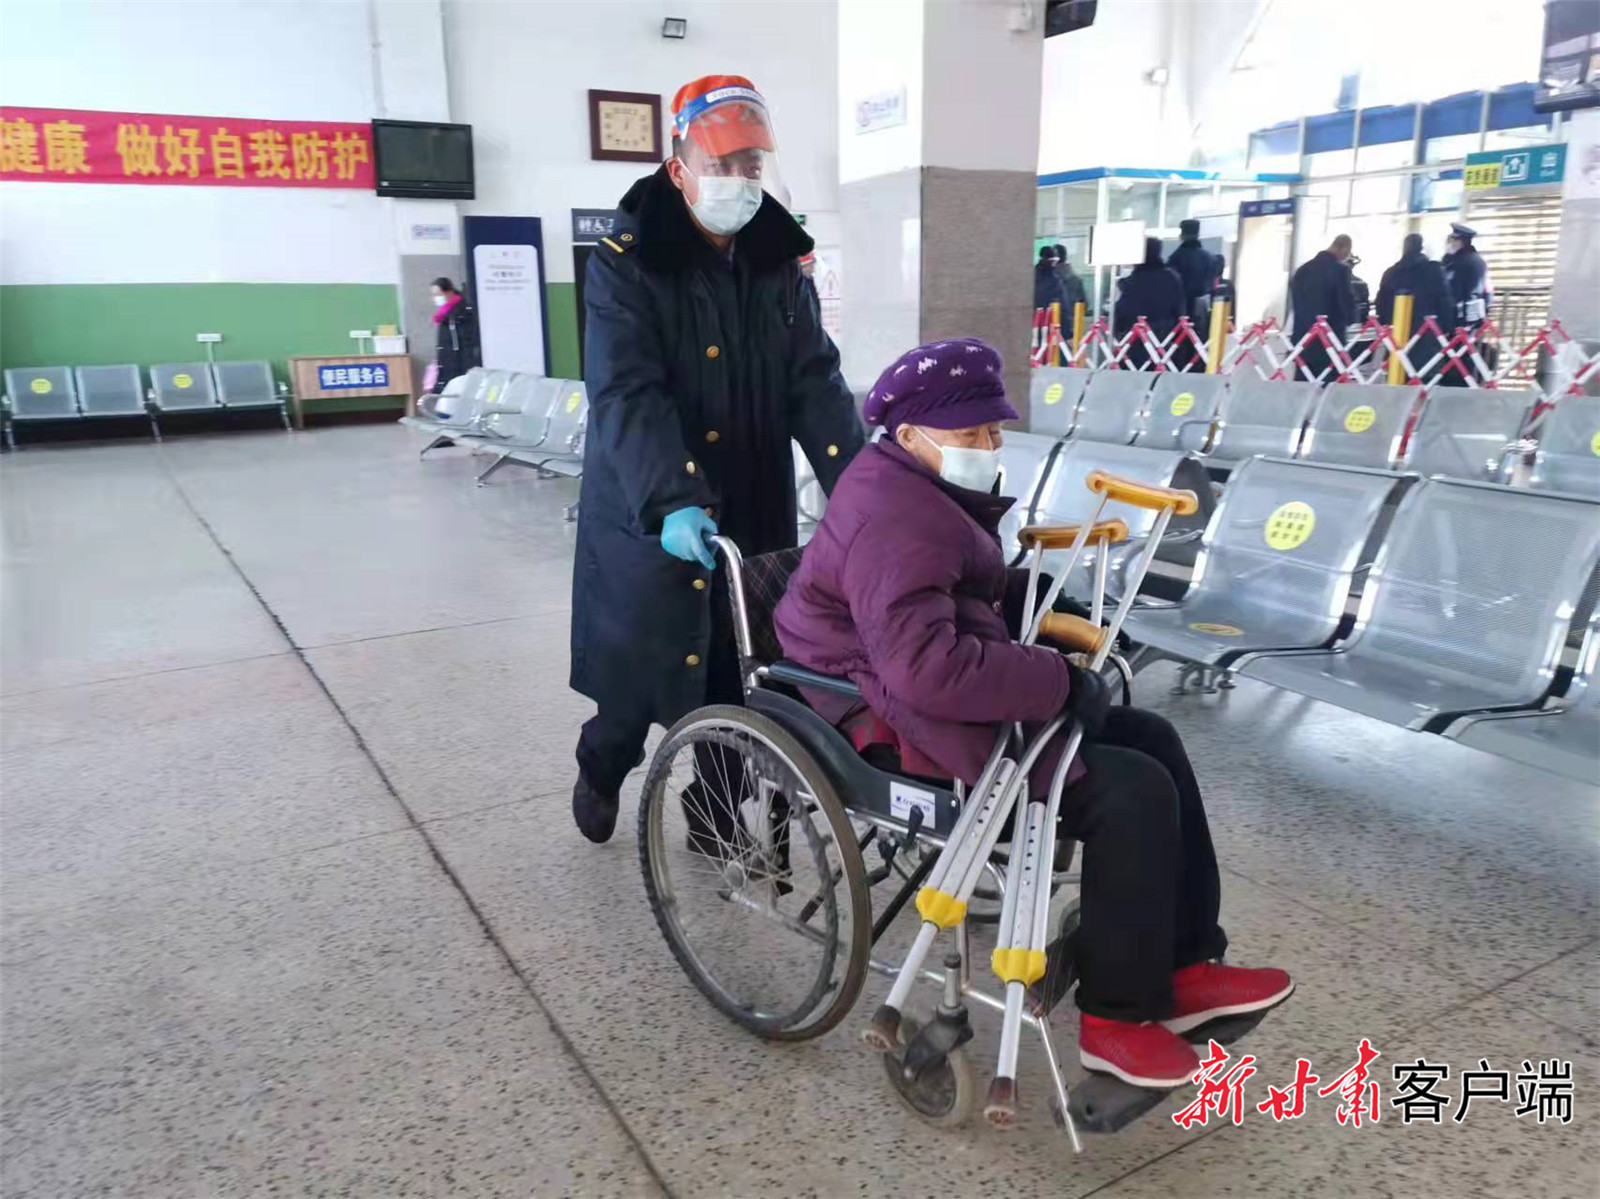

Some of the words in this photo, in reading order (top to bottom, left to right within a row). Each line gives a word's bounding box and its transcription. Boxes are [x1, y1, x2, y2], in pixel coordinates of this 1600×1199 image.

[0, 117, 91, 174] 健康
[115, 121, 369, 180] 做好自我防护
[321, 367, 387, 386] 便民服务台
